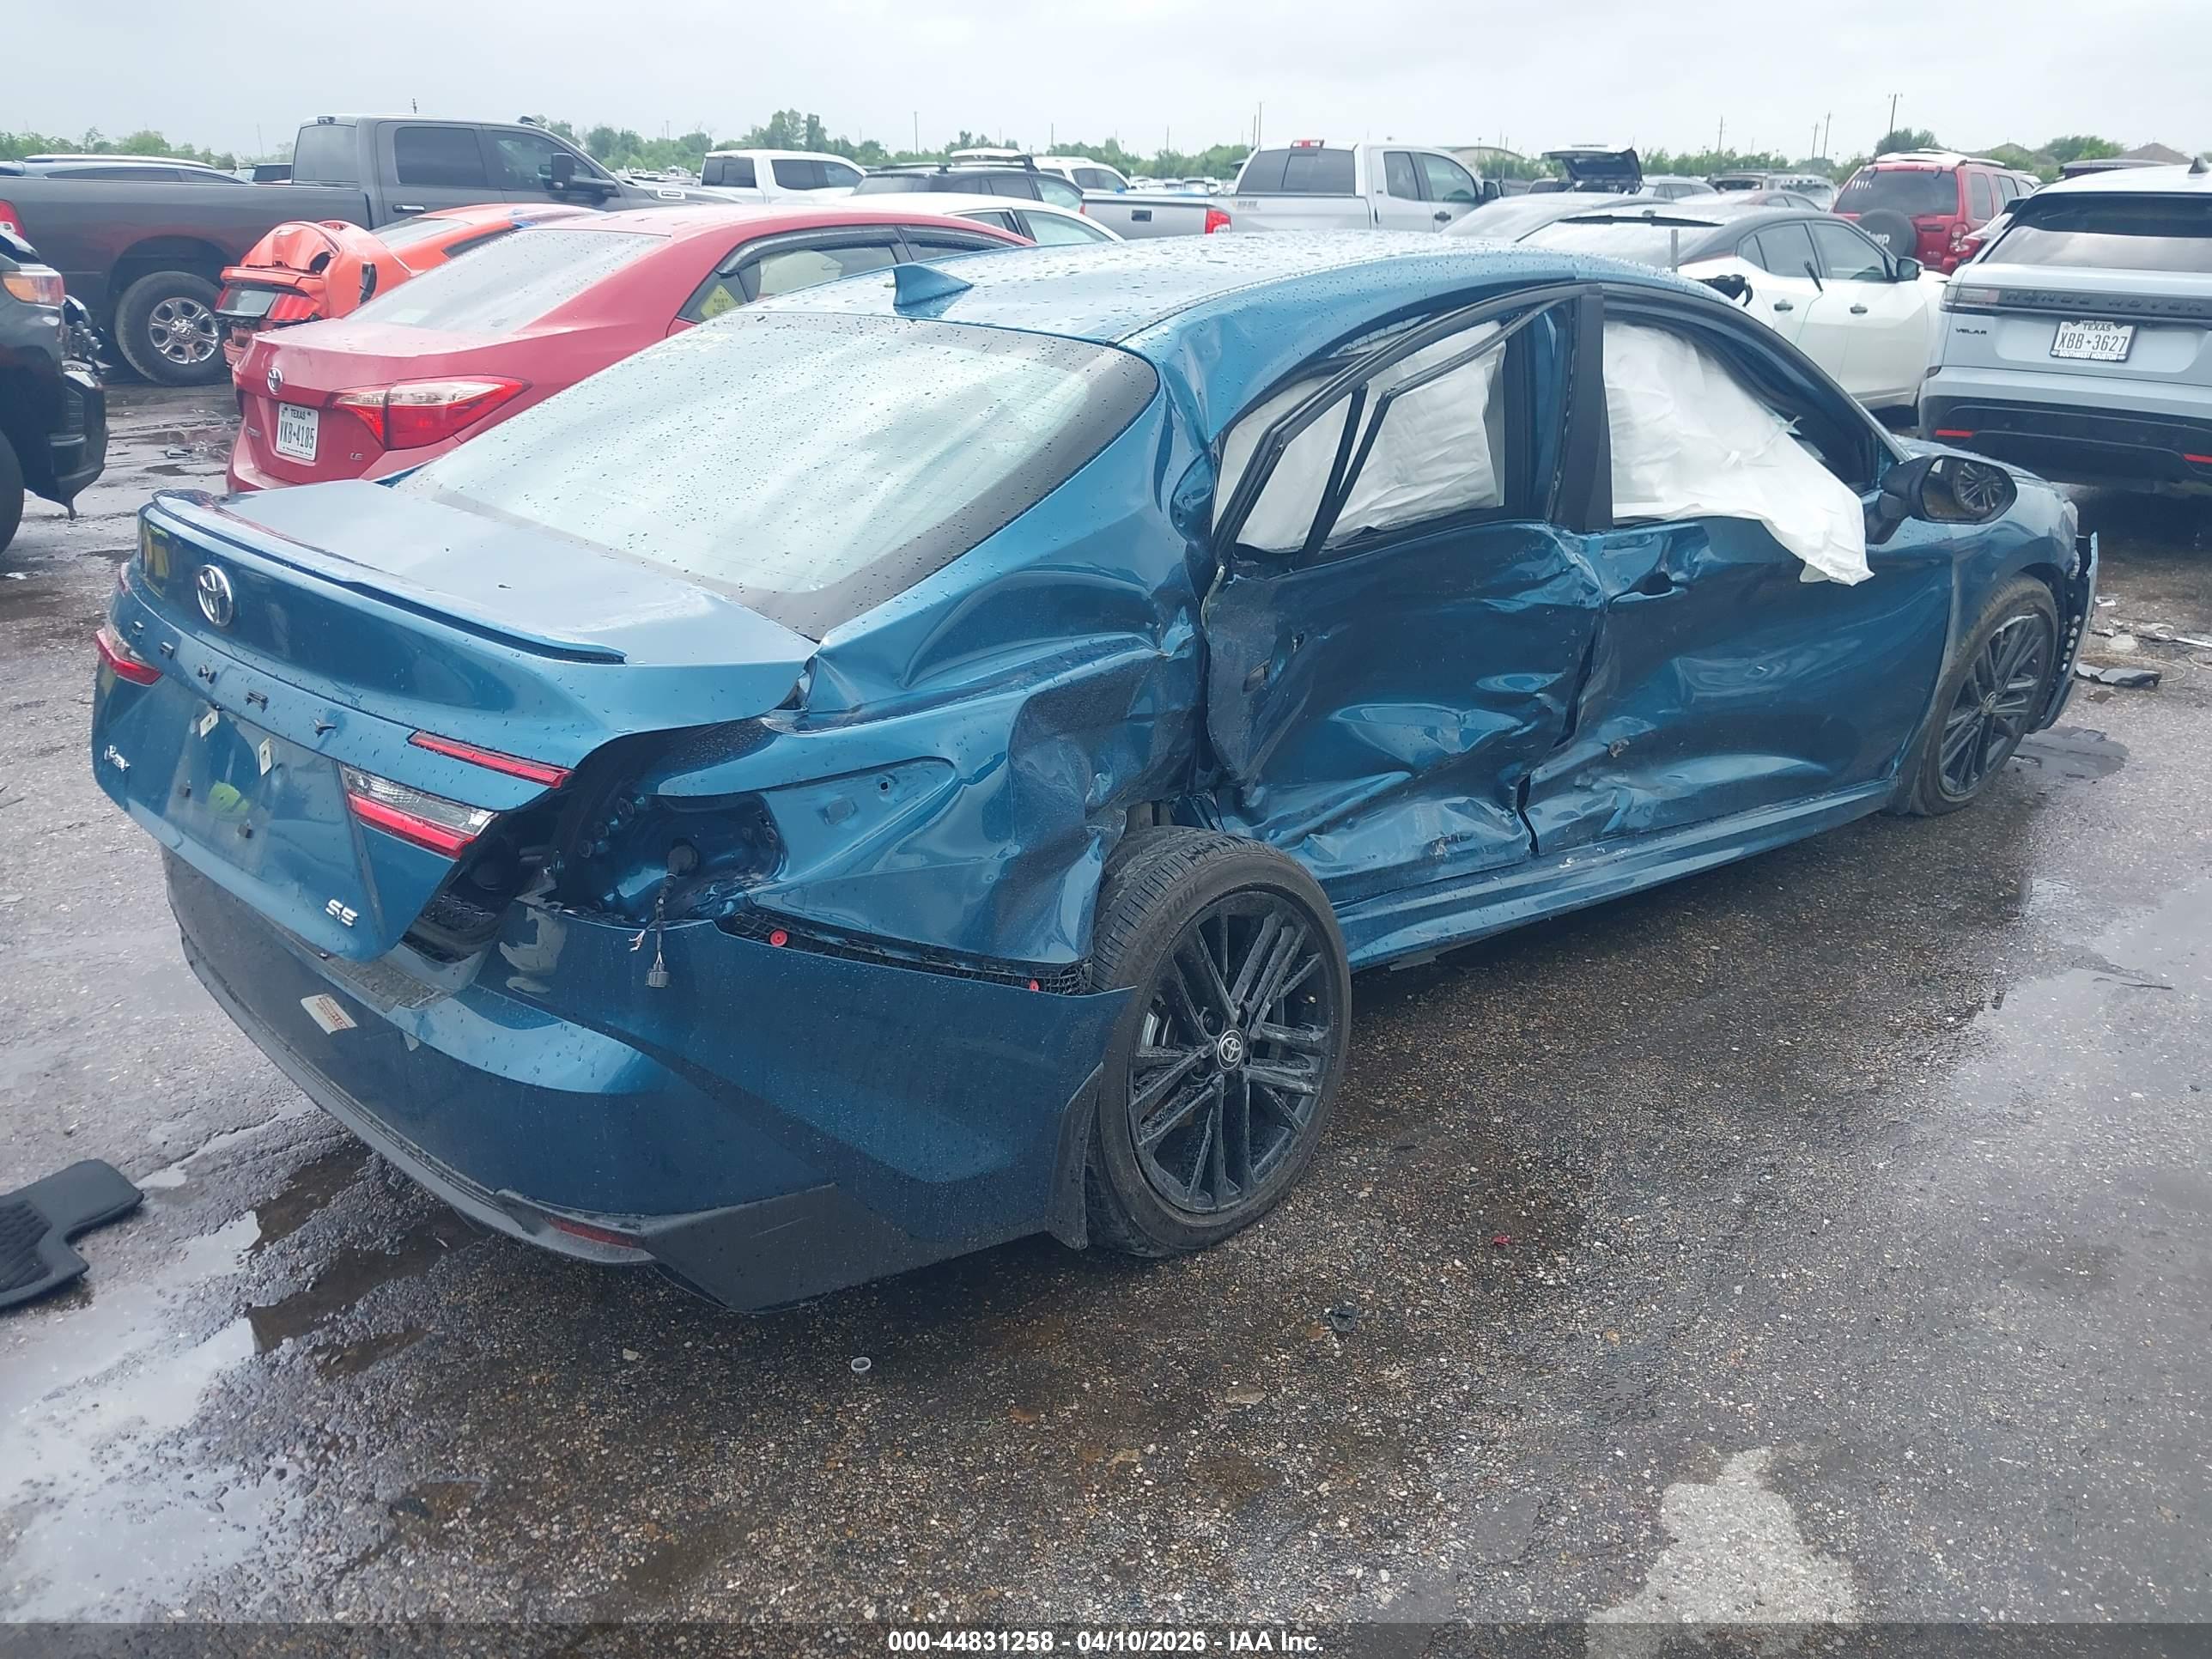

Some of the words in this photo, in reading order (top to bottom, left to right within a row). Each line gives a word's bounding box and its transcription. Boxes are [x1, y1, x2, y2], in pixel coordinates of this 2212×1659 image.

[2006, 291, 2091, 306] RANGE
[2107, 297, 2204, 313] ROVER
[1955, 327, 1988, 336] VELAR
[2082, 323, 2112, 332] TEXAS
[290, 408, 307, 421] TEXAS
[349, 452, 364, 461] LE
[325, 898, 358, 927] SE
